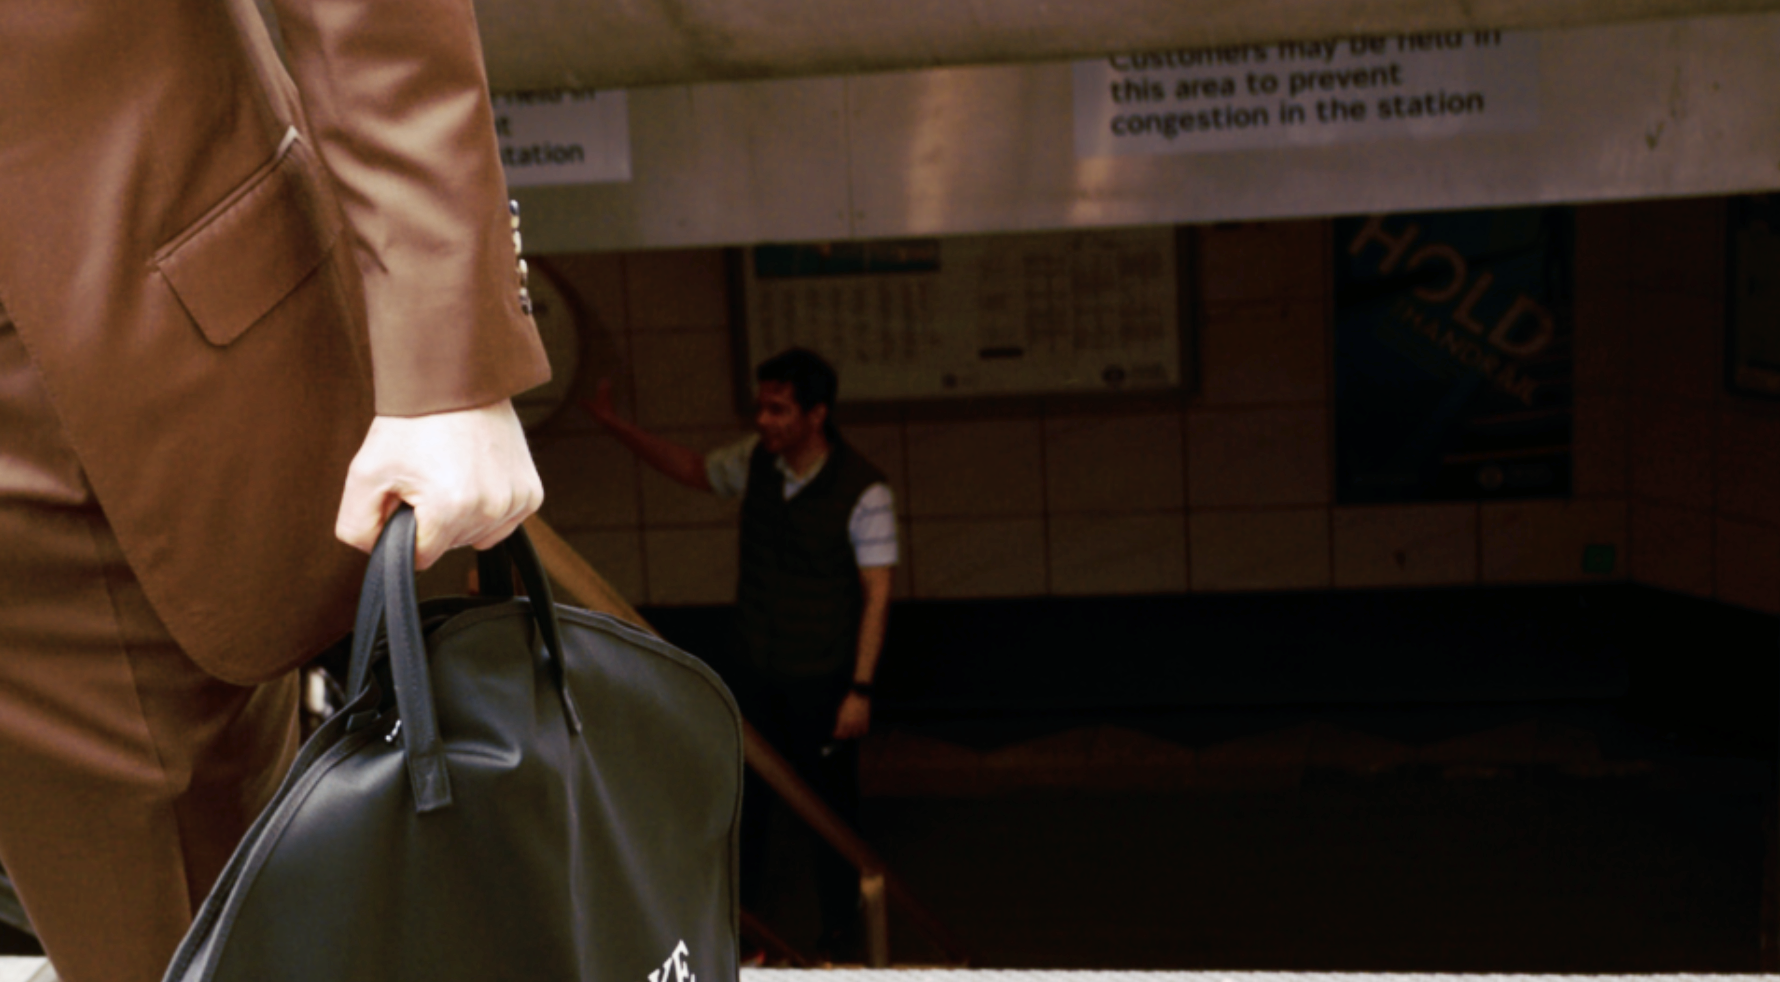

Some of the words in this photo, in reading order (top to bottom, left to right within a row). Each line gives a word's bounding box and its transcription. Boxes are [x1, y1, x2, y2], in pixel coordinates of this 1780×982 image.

[1278, 36, 1338, 64] may
[1111, 77, 1165, 103] this
[1175, 76, 1235, 99] area
[1246, 71, 1278, 95] to
[1289, 62, 1401, 96] prevent
[1110, 105, 1269, 140] congestion
[1279, 101, 1306, 126] in
[1317, 95, 1367, 123] the
[1378, 90, 1485, 120] station
[501, 141, 584, 167] tation
[1346, 213, 1555, 355] HOLD
